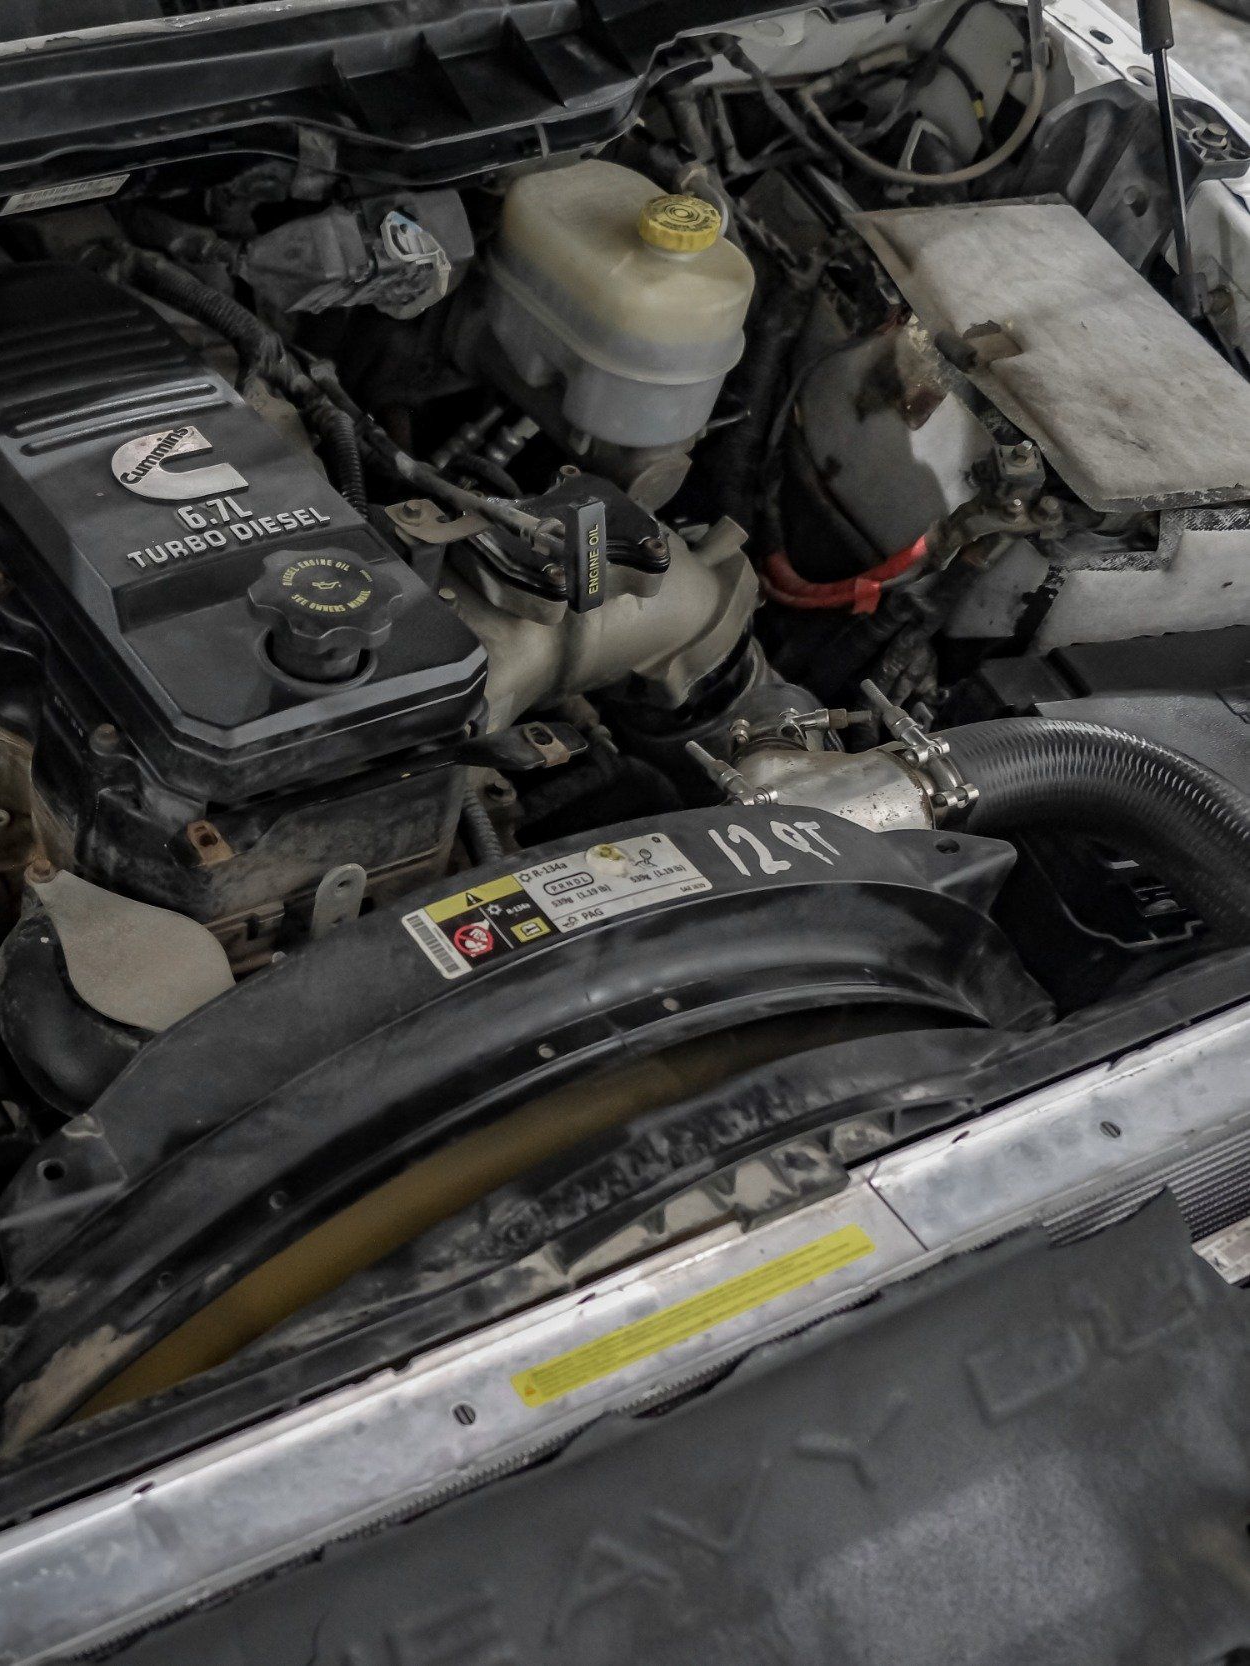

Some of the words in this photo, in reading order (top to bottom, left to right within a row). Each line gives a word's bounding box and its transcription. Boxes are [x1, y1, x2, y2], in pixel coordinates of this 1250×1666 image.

[119, 426, 190, 485] Cummins
[176, 495, 254, 531] 6.7L
[126, 529, 227, 569] TURBO
[229, 506, 332, 542] DIESEL
[588, 523, 600, 547] OIL
[282, 566, 300, 586] DIESEL
[297, 558, 333, 569] ENGINE
[334, 561, 351, 572] OIL
[589, 548, 600, 595] ENGINE
[291, 593, 309, 606] SEE
[707, 823, 792, 877] 12
[531, 862, 568, 877] R-134a
[581, 907, 605, 921] PAG
